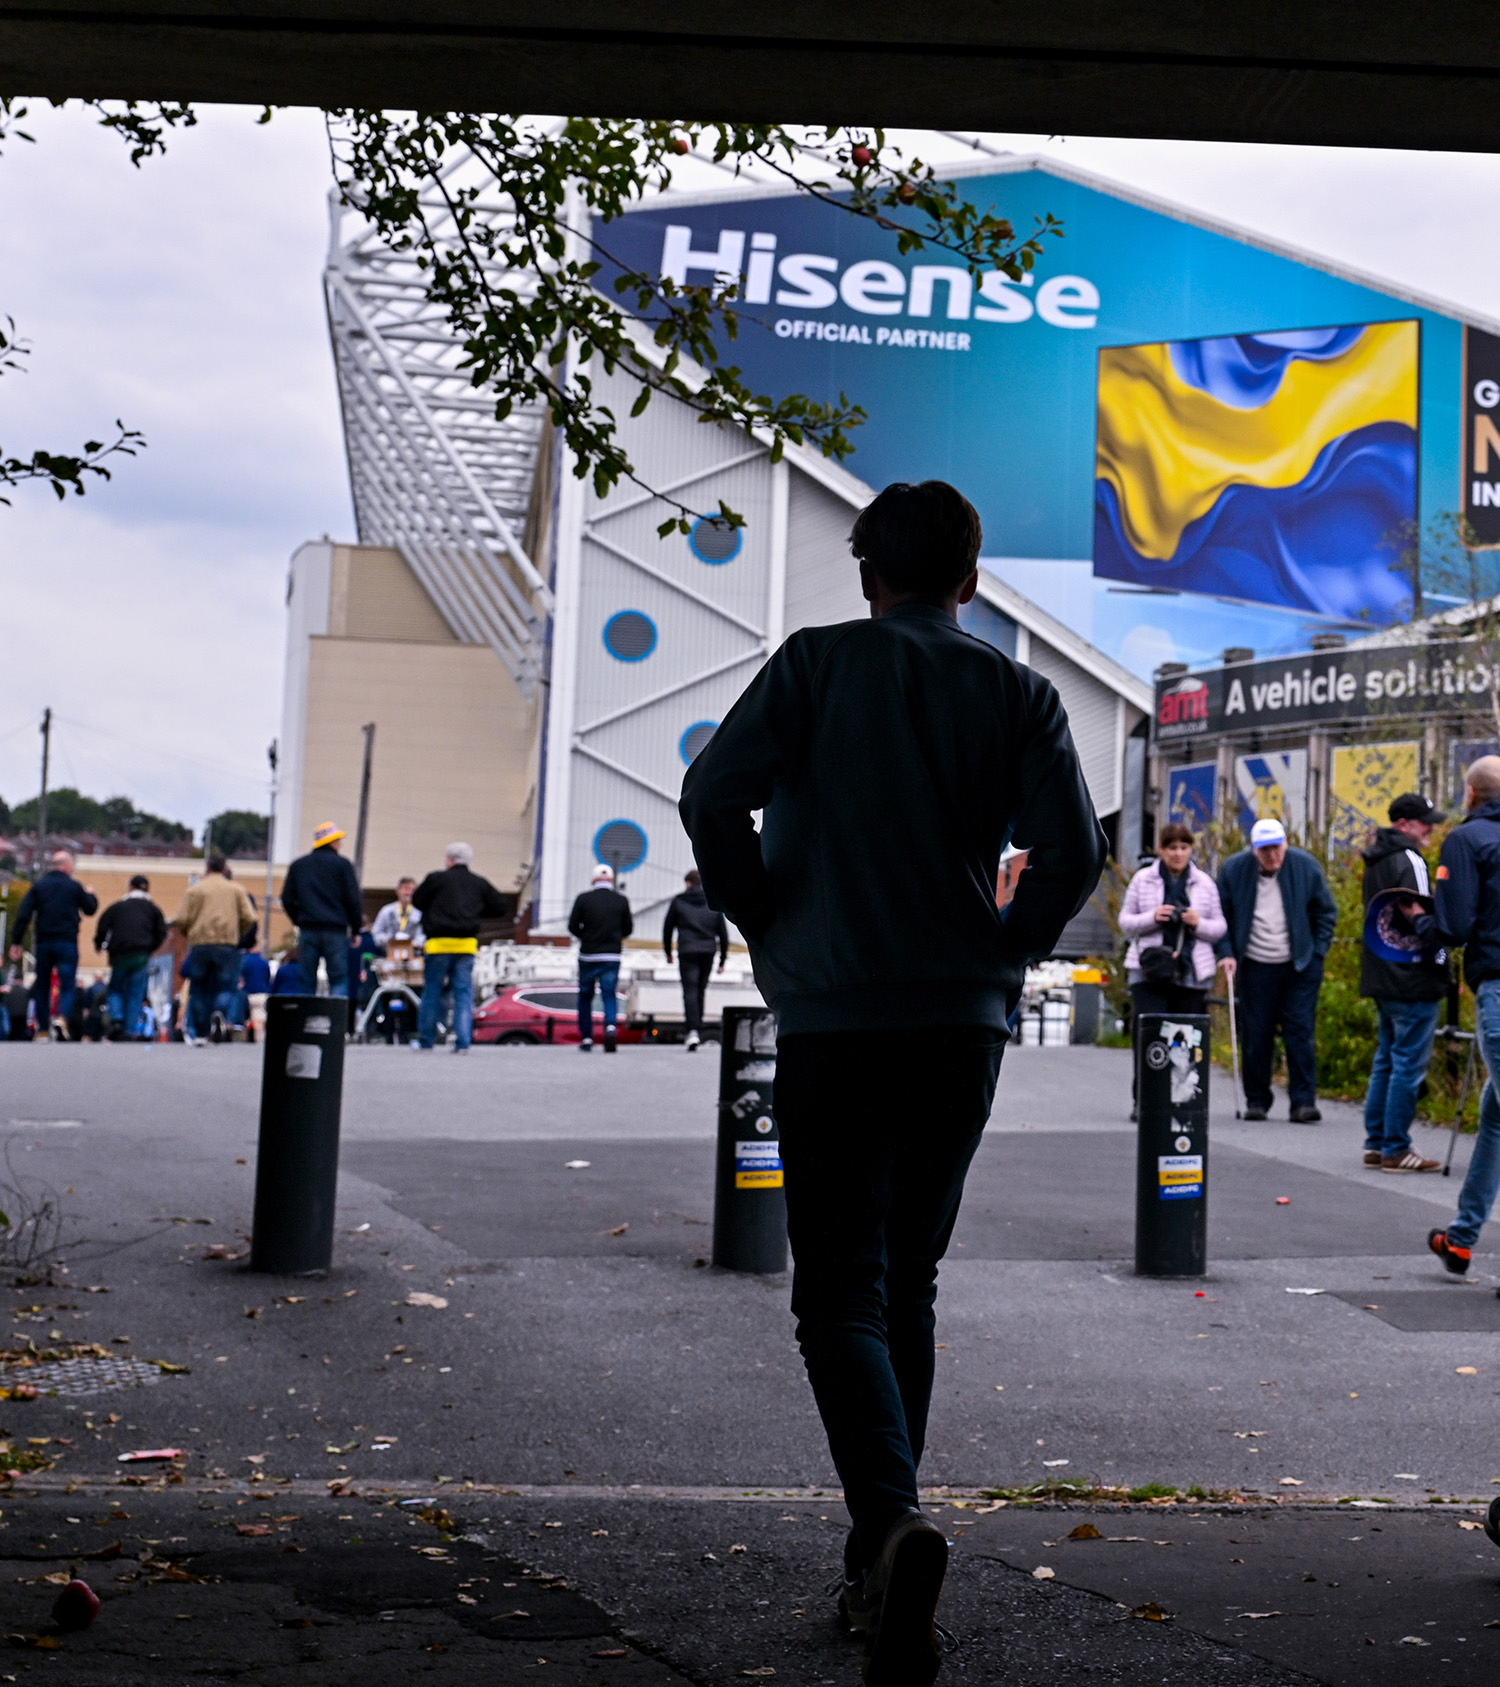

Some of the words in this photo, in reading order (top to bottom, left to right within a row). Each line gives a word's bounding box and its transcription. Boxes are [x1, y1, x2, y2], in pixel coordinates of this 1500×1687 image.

[658, 224, 1100, 329] Hisense
[774, 318, 872, 345] OFFICIAL
[876, 327, 971, 351] PARTNER
[1224, 679, 1246, 716] A
[1251, 665, 1357, 711] vehicle
